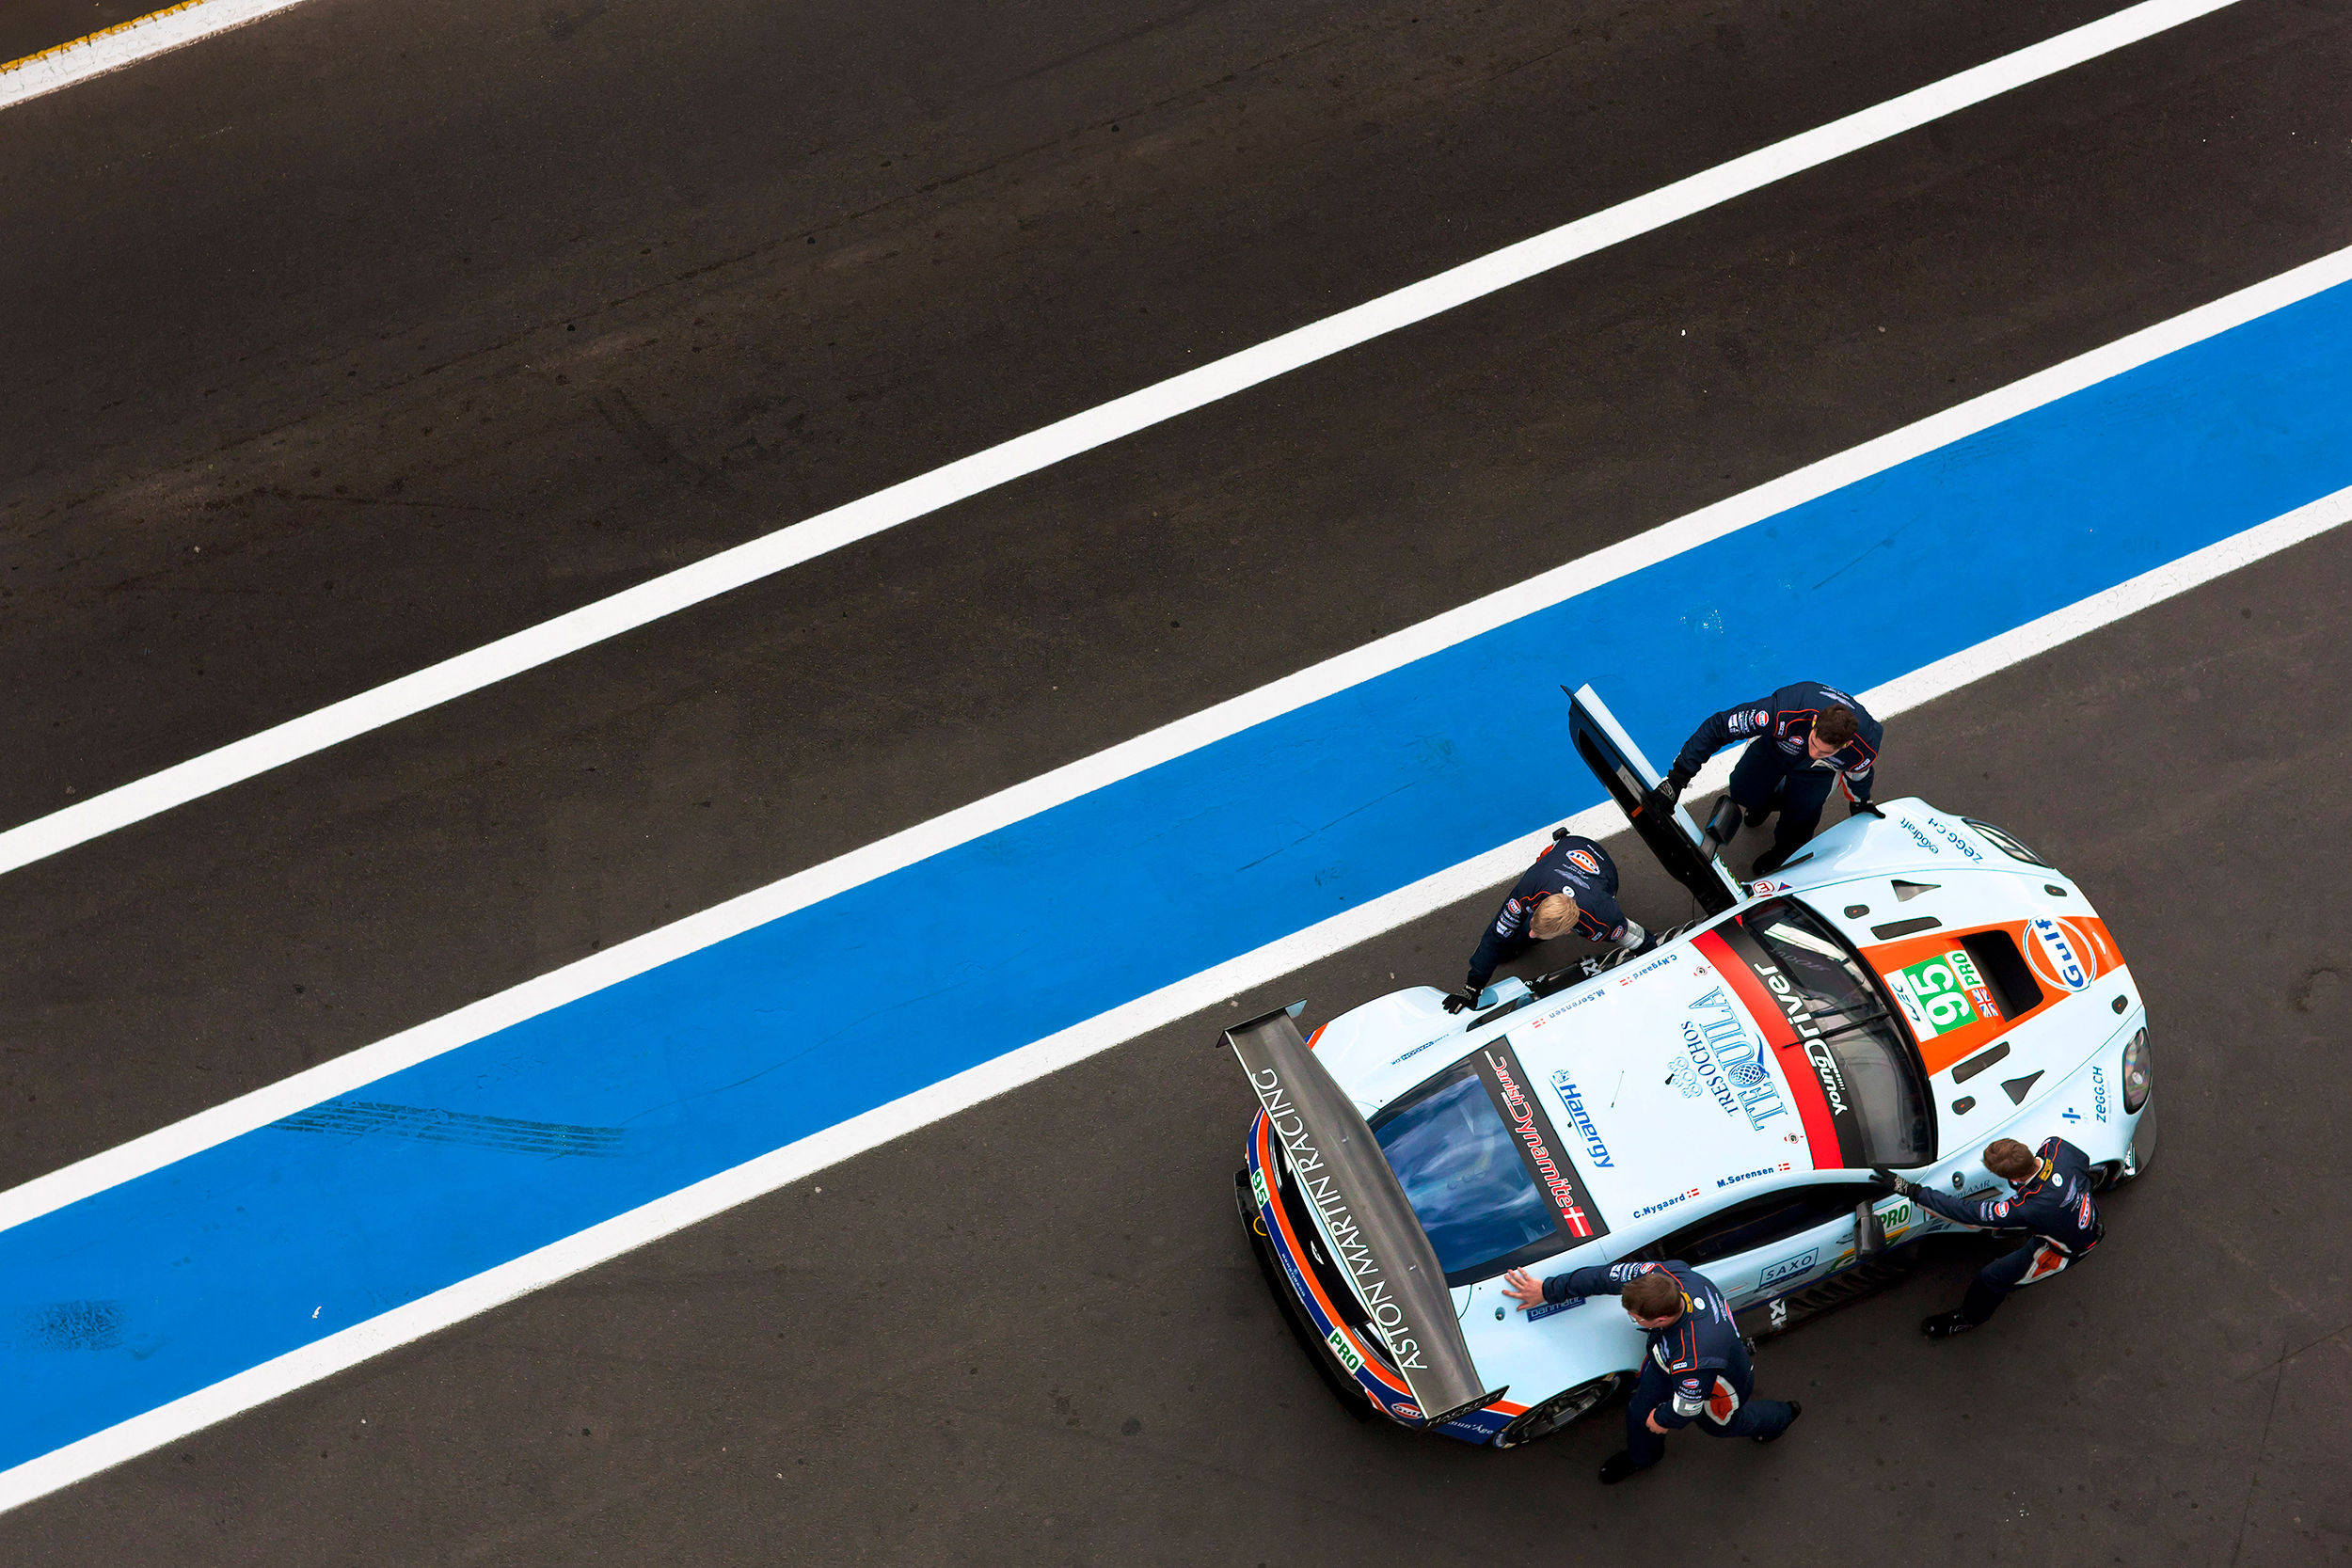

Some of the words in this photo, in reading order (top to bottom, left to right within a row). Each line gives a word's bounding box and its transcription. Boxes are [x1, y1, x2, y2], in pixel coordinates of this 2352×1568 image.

[1900, 817, 1939, 854] exodraft
[1952, 953, 1980, 986] PRO
[2035, 919, 2084, 988] Gulf
[1908, 964, 1970, 1025] 95
[1680, 1021, 1717, 1076] OCHOS
[1688, 986, 1788, 1132] TEQUILA
[1707, 1076, 1740, 1117] TRES
[1252, 1068, 1326, 1175] RACING
[1559, 1083, 1615, 1168] Hanergy
[1252, 1170, 1266, 1206] 95
[1633, 1193, 1686, 1219] C.Nygaard
[1308, 1175, 1380, 1276] MARTIN
[1766, 1255, 1812, 1280] SAXO
[1363, 1278, 1429, 1370] ASTON
[1330, 1331, 1360, 1371] PRO
[1392, 1404, 1422, 1418] Gulf
[1427, 1392, 1504, 1428] HACKETT
